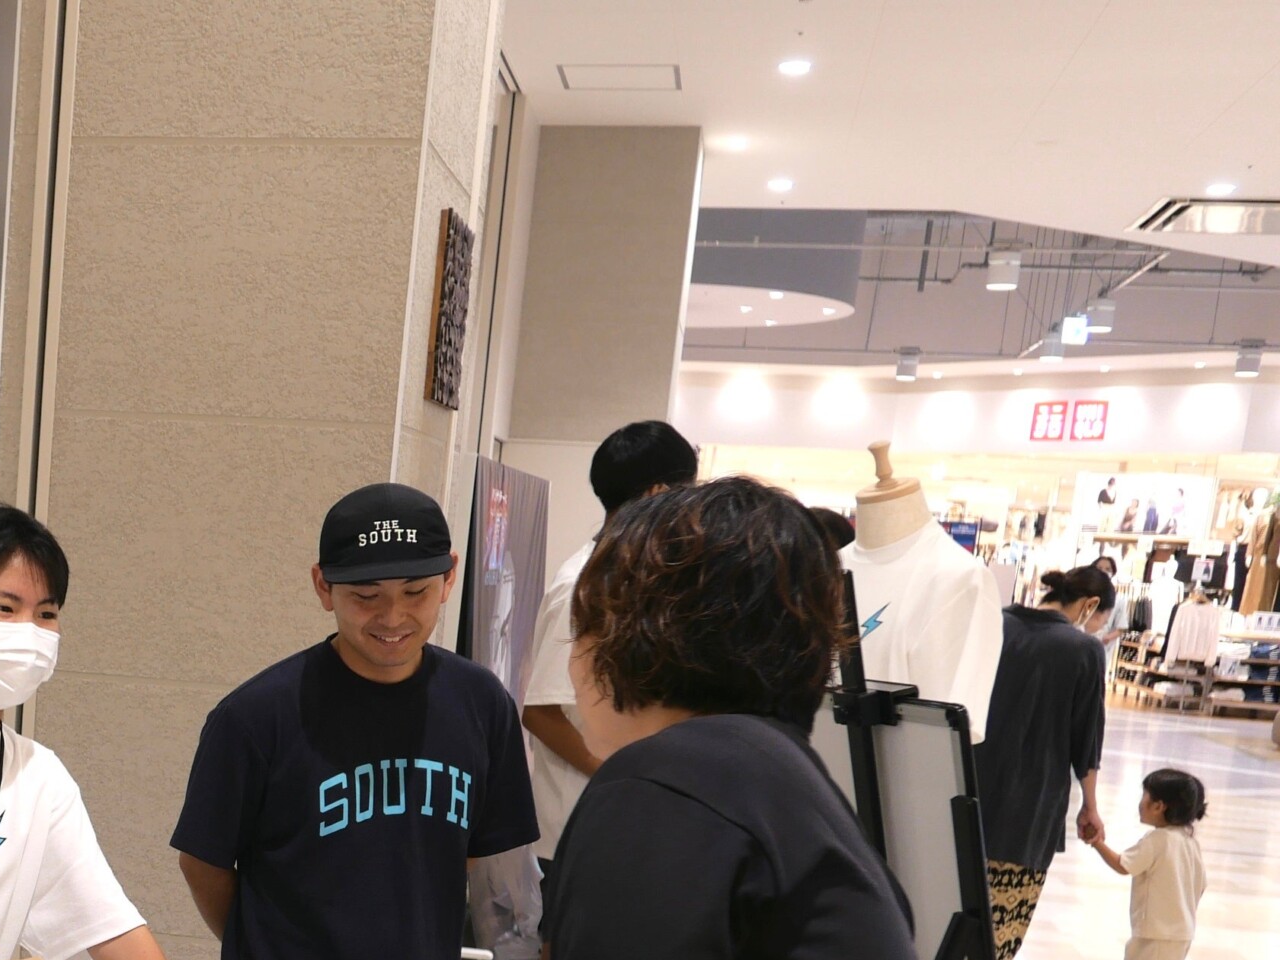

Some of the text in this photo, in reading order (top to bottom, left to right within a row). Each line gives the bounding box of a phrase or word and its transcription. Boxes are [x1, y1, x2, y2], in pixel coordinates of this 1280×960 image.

[373, 519, 400, 531] THE
[358, 528, 418, 547] SOUTH
[319, 758, 472, 837] SOUTH
